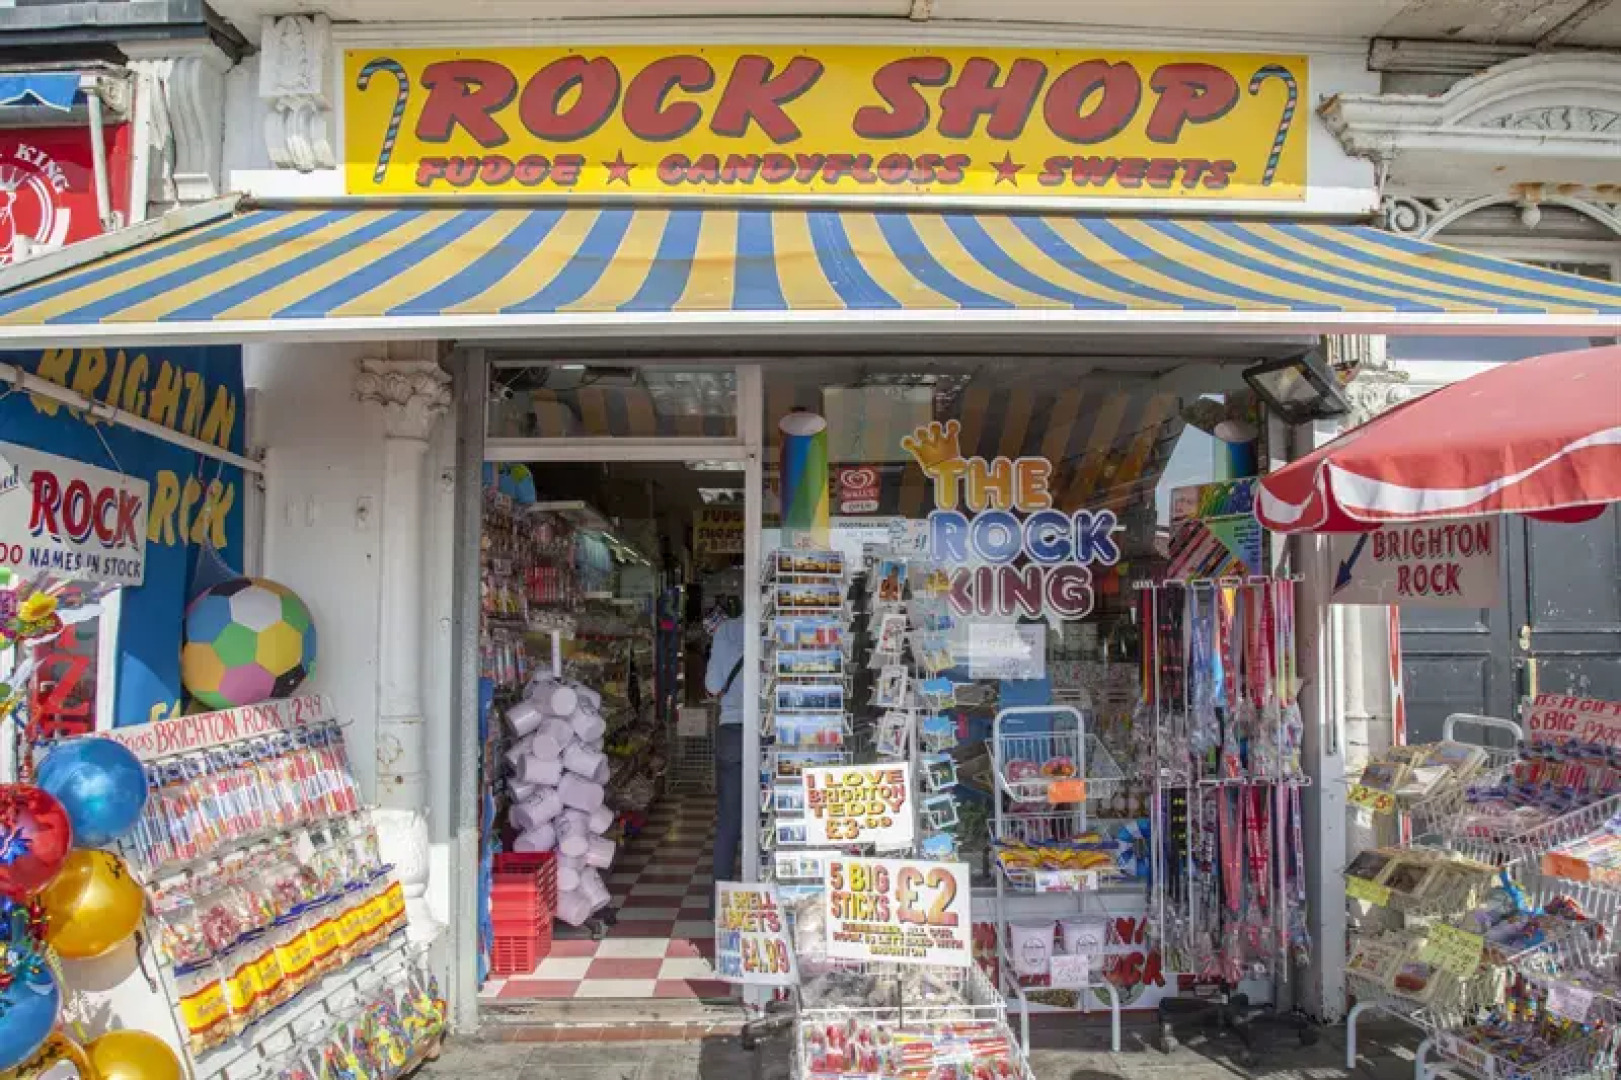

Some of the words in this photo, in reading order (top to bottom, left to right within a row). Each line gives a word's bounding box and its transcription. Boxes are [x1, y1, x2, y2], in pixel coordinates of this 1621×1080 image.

[415, 54, 825, 148] ROCK
[852, 56, 1240, 145] SHOP
[14, 143, 70, 195] KING
[416, 154, 586, 187] FUDGE
[657, 153, 971, 187] CANDYFLOSS
[1038, 156, 1237, 189] SWEETS
[929, 457, 1053, 511] THE
[27, 469, 143, 552] ROCK
[927, 509, 1121, 565] ROCK
[1373, 522, 1491, 561] BRIGHTON
[30, 547, 82, 570] NAMES
[87, 553, 100, 574] IN
[103, 557, 141, 578] STOCK
[1397, 563, 1462, 596] ROCK
[948, 562, 1095, 620] KING
[154, 707, 238, 755] BRIGHTON
[242, 702, 284, 734] ROCK
[1543, 711, 1577, 730] BIG
[806, 773, 815, 789] I
[825, 769, 904, 787] LOVE
[808, 784, 906, 803] BRIGHTON
[808, 799, 905, 818] TEDDY
[829, 862, 844, 891] 5
[849, 862, 890, 894] BIG
[894, 866, 959, 927] £2
[829, 890, 890, 923] STICKS
